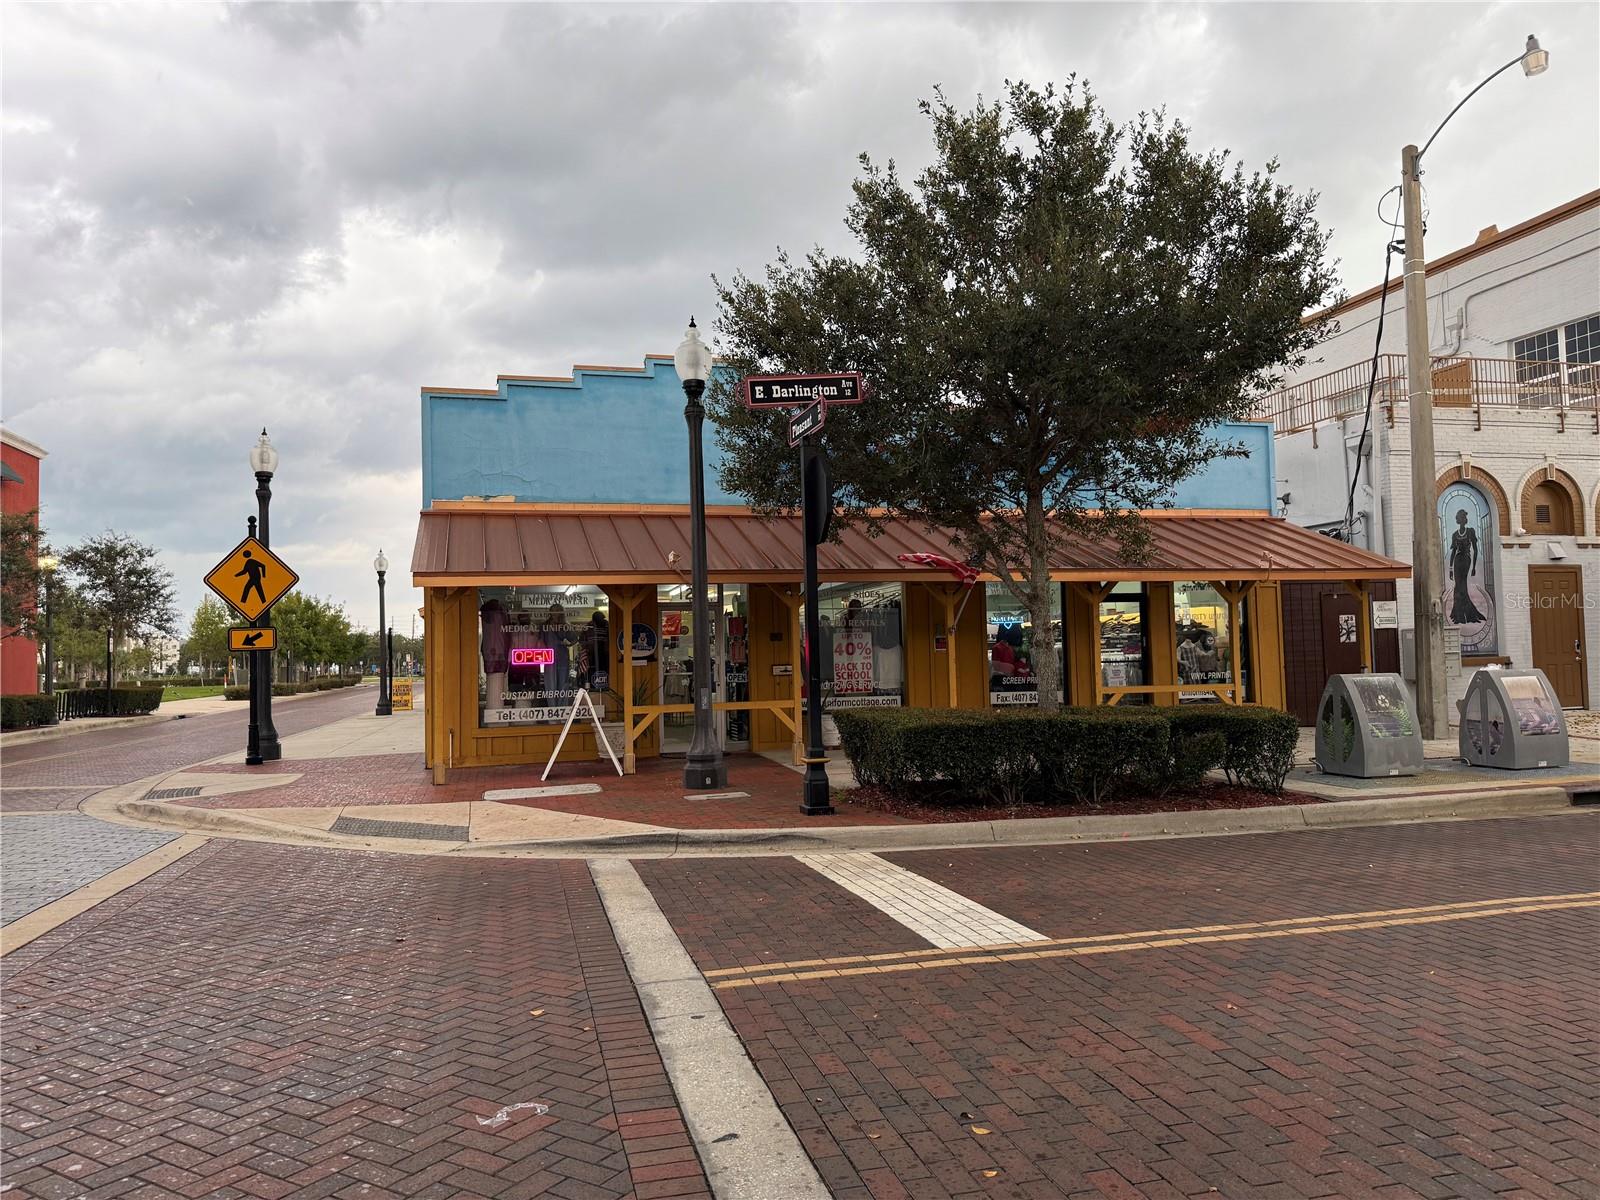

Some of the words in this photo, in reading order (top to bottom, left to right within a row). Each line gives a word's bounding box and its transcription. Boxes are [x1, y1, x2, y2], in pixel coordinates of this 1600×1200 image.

[755, 385, 767, 399] E.
[772, 384, 838, 398] Darlington
[841, 379, 853, 388] Ave
[792, 413, 812, 438] Pleasant
[500, 624, 540, 633] MEDICAL
[834, 642, 872, 656] 40%
[514, 650, 552, 663] OPEN
[834, 663, 858, 671] BACK
[860, 662, 872, 670] TO
[835, 671, 872, 681] SCHOOL
[1002, 676, 1026, 685] SCREEN
[1190, 671, 1207, 680] VINYL
[500, 691, 535, 700] CUSTOM
[996, 693, 1011, 703] Fax:
[1011, 693, 1028, 702] (407)
[496, 710, 516, 721] Tel:
[518, 709, 545, 720] (407)
[547, 707, 593, 718] 847-920
